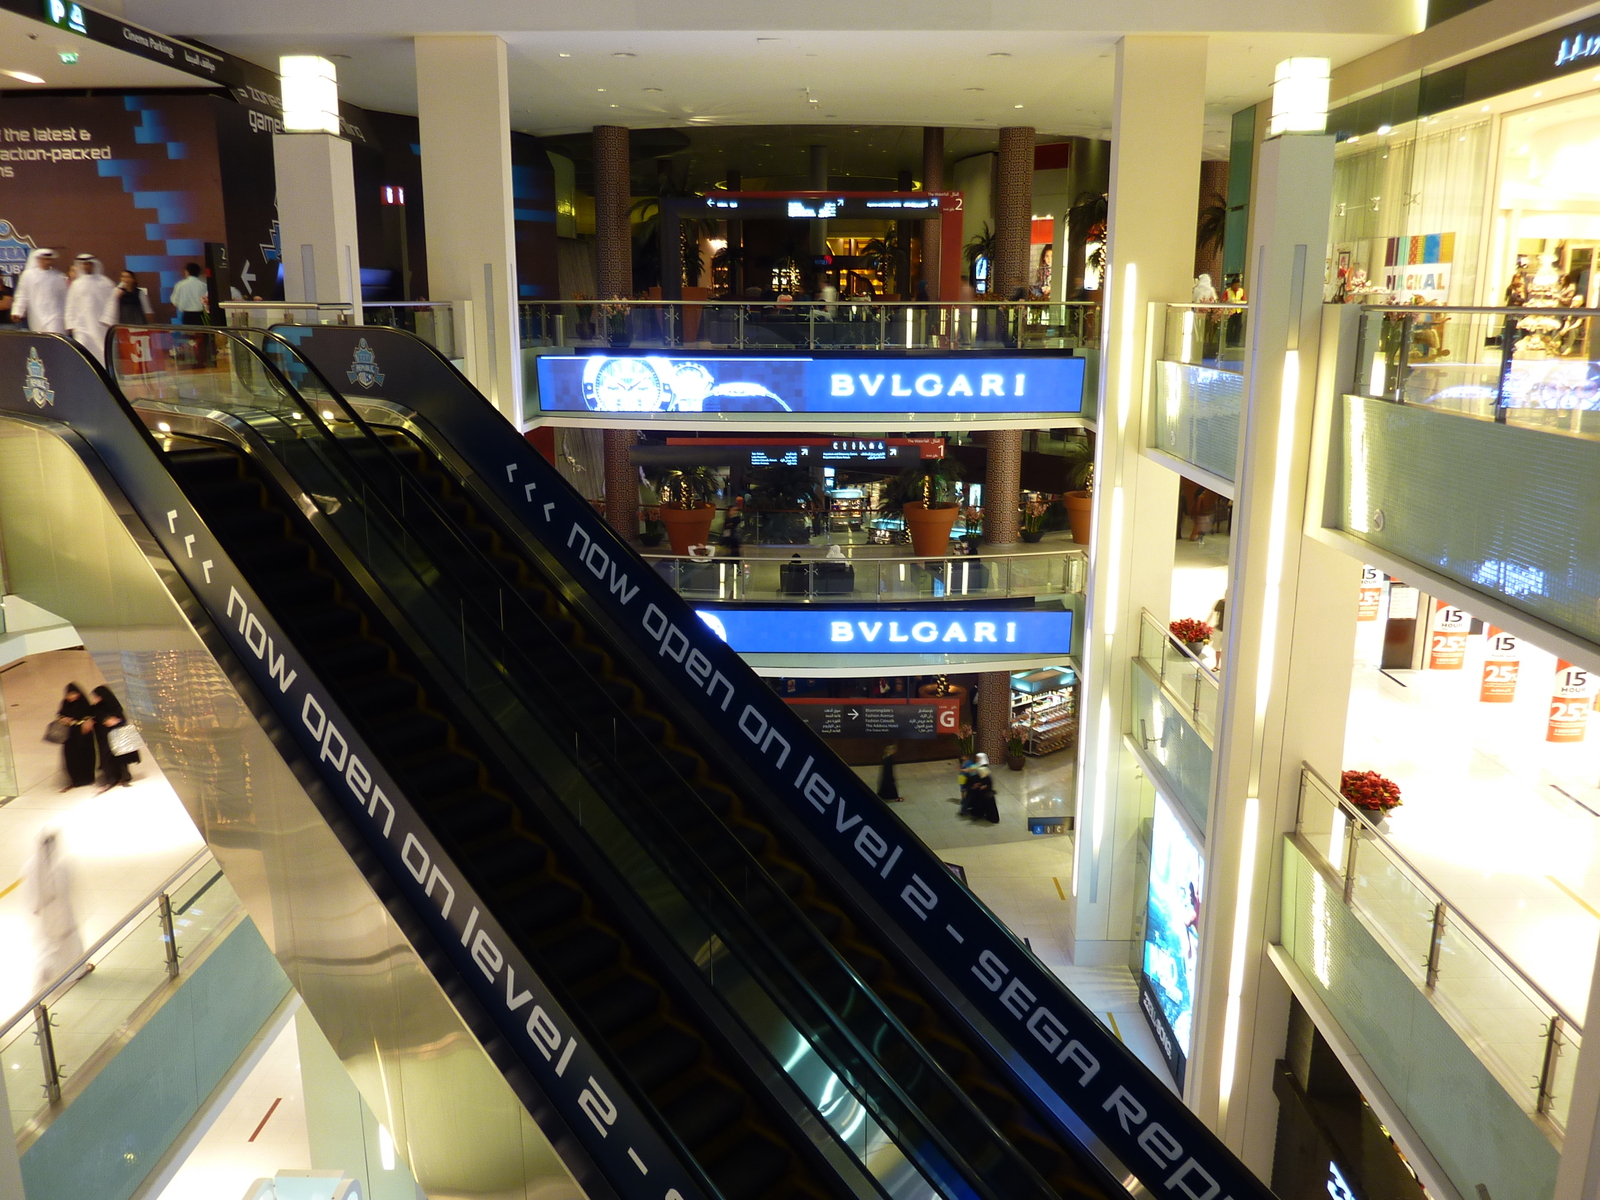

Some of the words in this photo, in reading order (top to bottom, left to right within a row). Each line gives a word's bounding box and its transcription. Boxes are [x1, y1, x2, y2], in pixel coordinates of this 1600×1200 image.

[122, 27, 149, 47] Cinema
[149, 37, 175, 60] Parking
[3, 127, 31, 142] the
[33, 126, 78, 142] latest
[79, 128, 92, 142] &
[0, 145, 112, 164] action-packed
[954, 198, 963, 211] 2
[830, 372, 1027, 398] BVLGARI
[937, 444, 945, 457] 1
[1362, 568, 1377, 580] 15
[1444, 609, 1463, 623] 15
[829, 620, 1018, 644] BVLGARI
[1495, 637, 1516, 651] 15
[1565, 671, 1588, 687] 15
[939, 710, 955, 728] G
[567, 522, 640, 605] now
[642, 603, 735, 712] open
[738, 704, 812, 770] on
[794, 755, 903, 879] level
[900, 873, 938, 921] 2
[971, 949, 1101, 1087] SEGA
[226, 585, 298, 694] now
[301, 692, 396, 839] open
[401, 832, 456, 920] on
[460, 905, 578, 1078] level
[577, 1075, 618, 1138] 2
